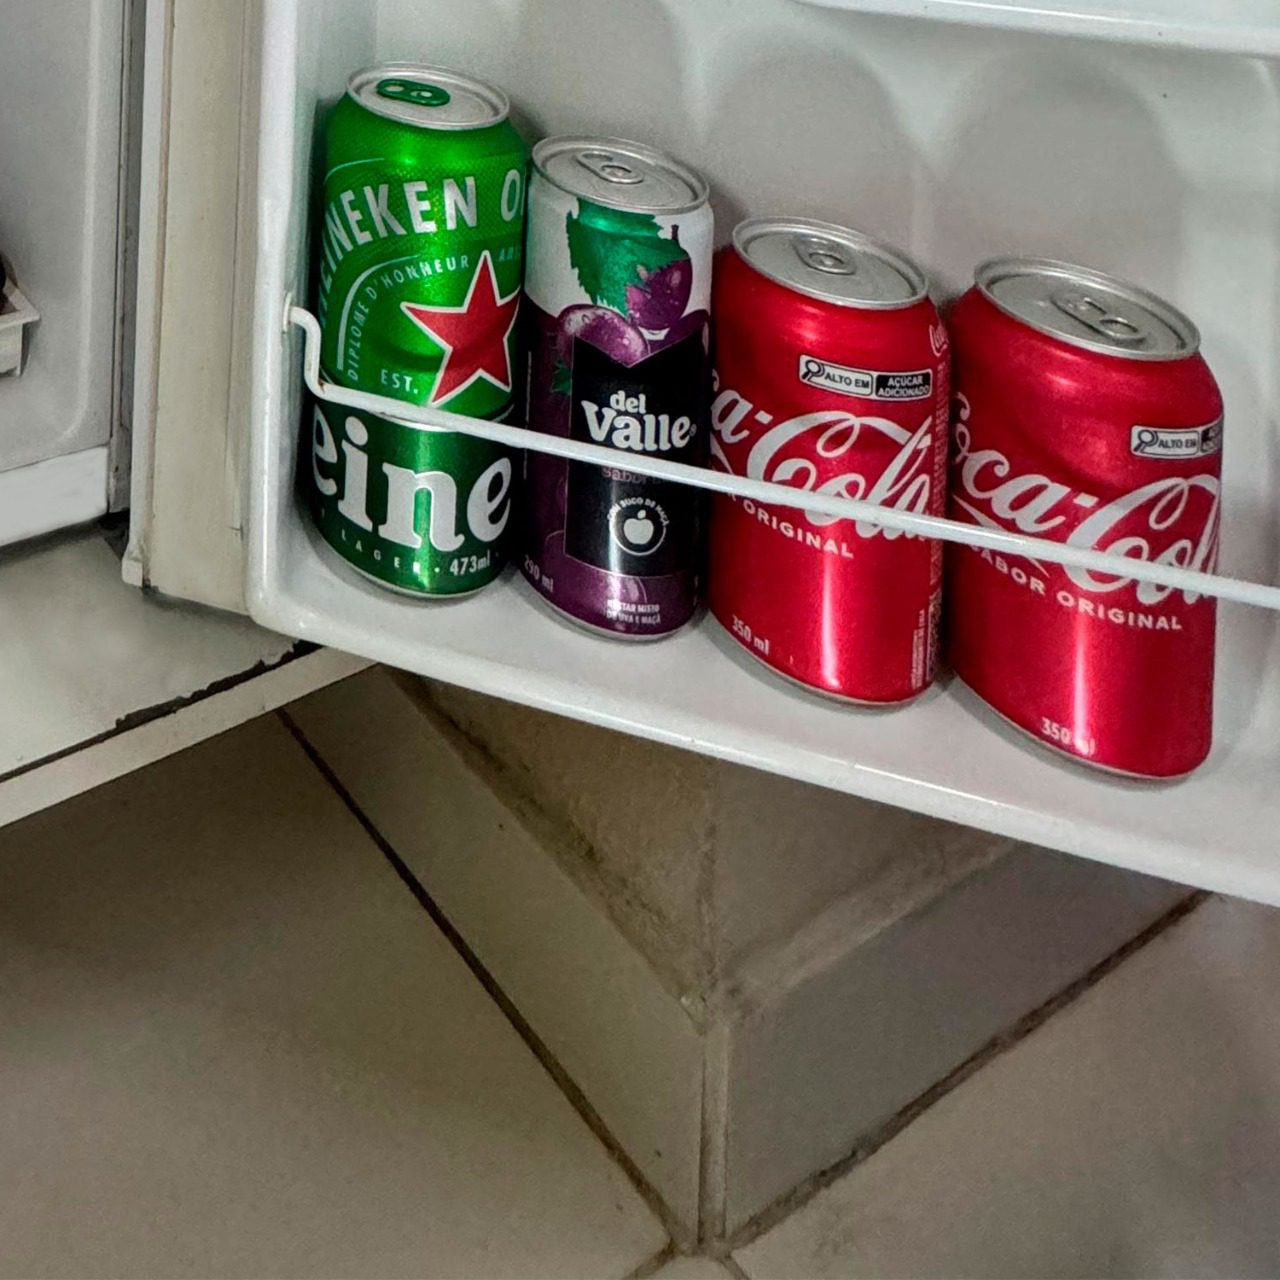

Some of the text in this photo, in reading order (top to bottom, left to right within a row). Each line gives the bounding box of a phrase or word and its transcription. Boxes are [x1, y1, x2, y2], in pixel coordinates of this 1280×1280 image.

[347, 301, 371, 382] DIPLOME
[367, 255, 469, 301] D'HONNEUR
[380, 369, 418, 395] EST.
[824, 371, 870, 389] ALTO EM
[878, 385, 930, 398] ADICIONADO
[887, 374, 923, 388] AÇÚCAR
[610, 390, 646, 414] del
[581, 400, 692, 451] Valle
[1158, 439, 1183, 449] ALTO
[645, 498, 657, 509] DE
[744, 501, 854, 558] ORIGINAL
[449, 549, 491, 577] 473ml
[1056, 591, 1183, 630] ORIGINAL
[732, 614, 770, 656] 350 ml
[1041, 716, 1071, 745] 350
